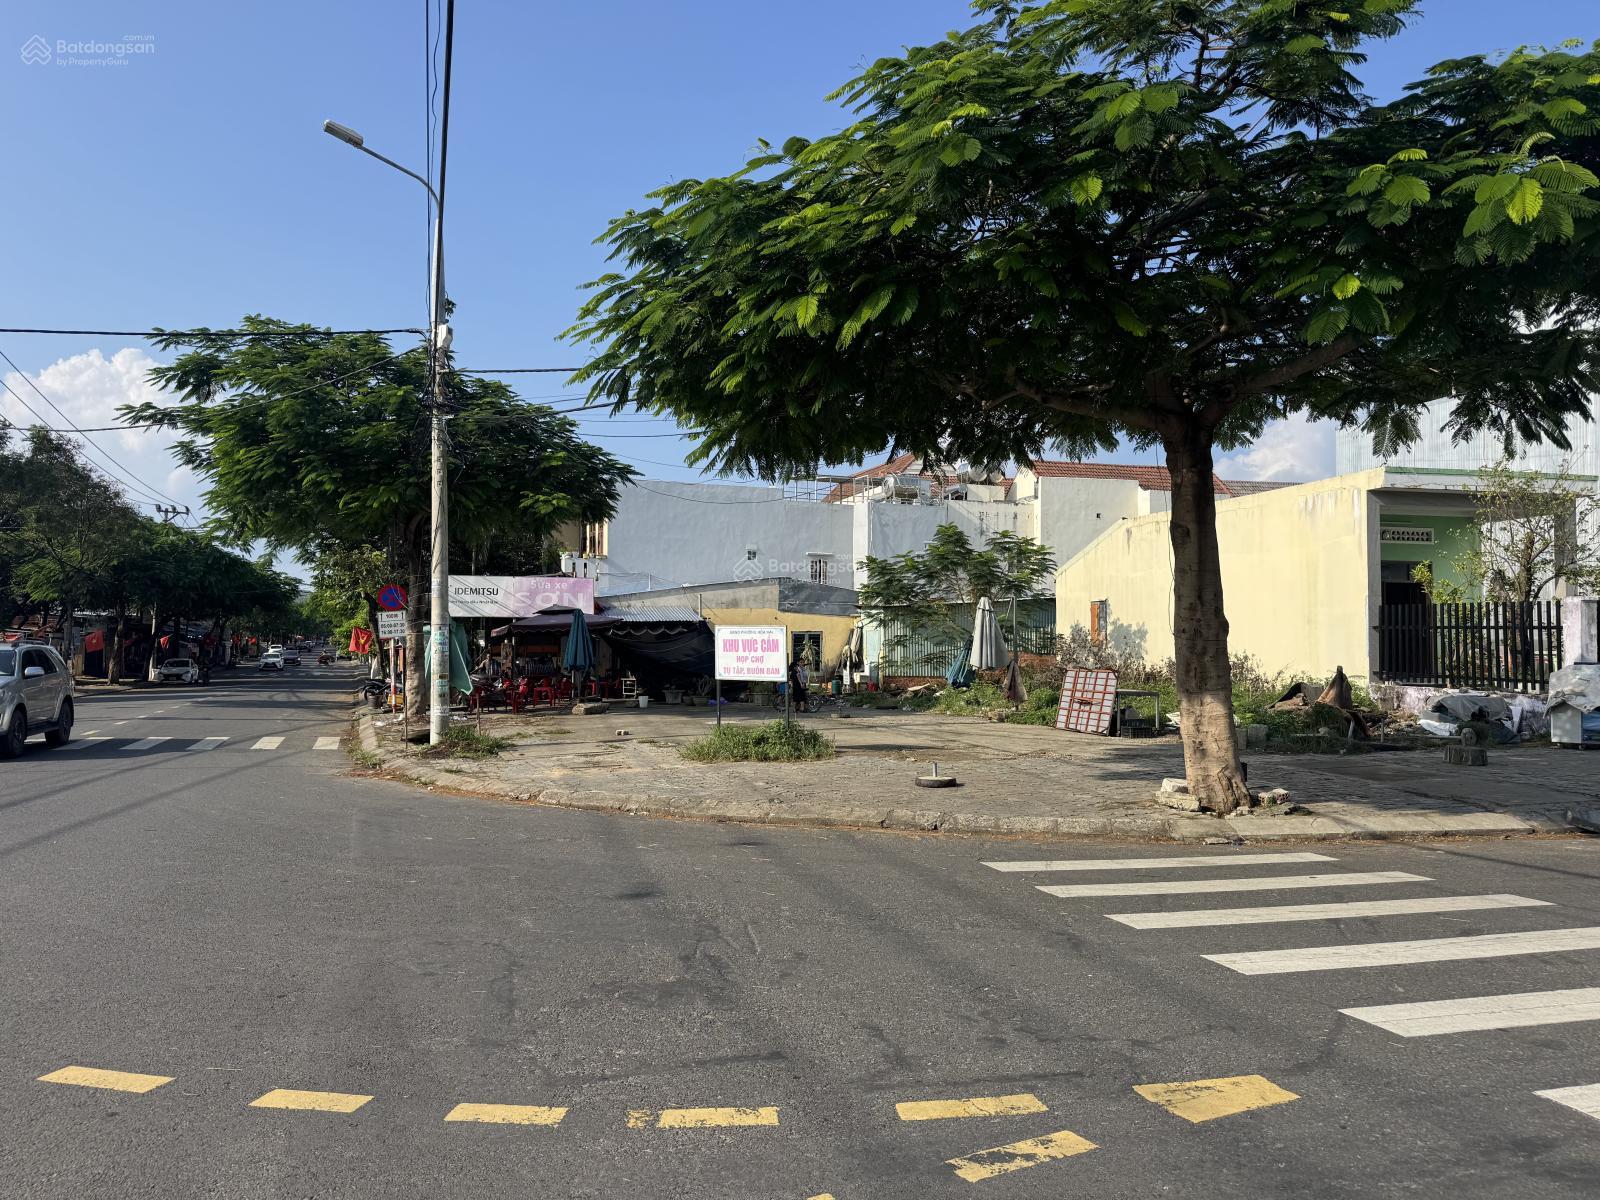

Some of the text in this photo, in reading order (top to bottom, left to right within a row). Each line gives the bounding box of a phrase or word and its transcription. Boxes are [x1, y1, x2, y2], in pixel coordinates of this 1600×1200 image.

[554, 581, 568, 589] xe
[454, 587, 499, 596] IDEMITSU
[723, 636, 779, 654] KHU VỰC CẤM
[736, 655, 765, 664] HỌP CHỢ
